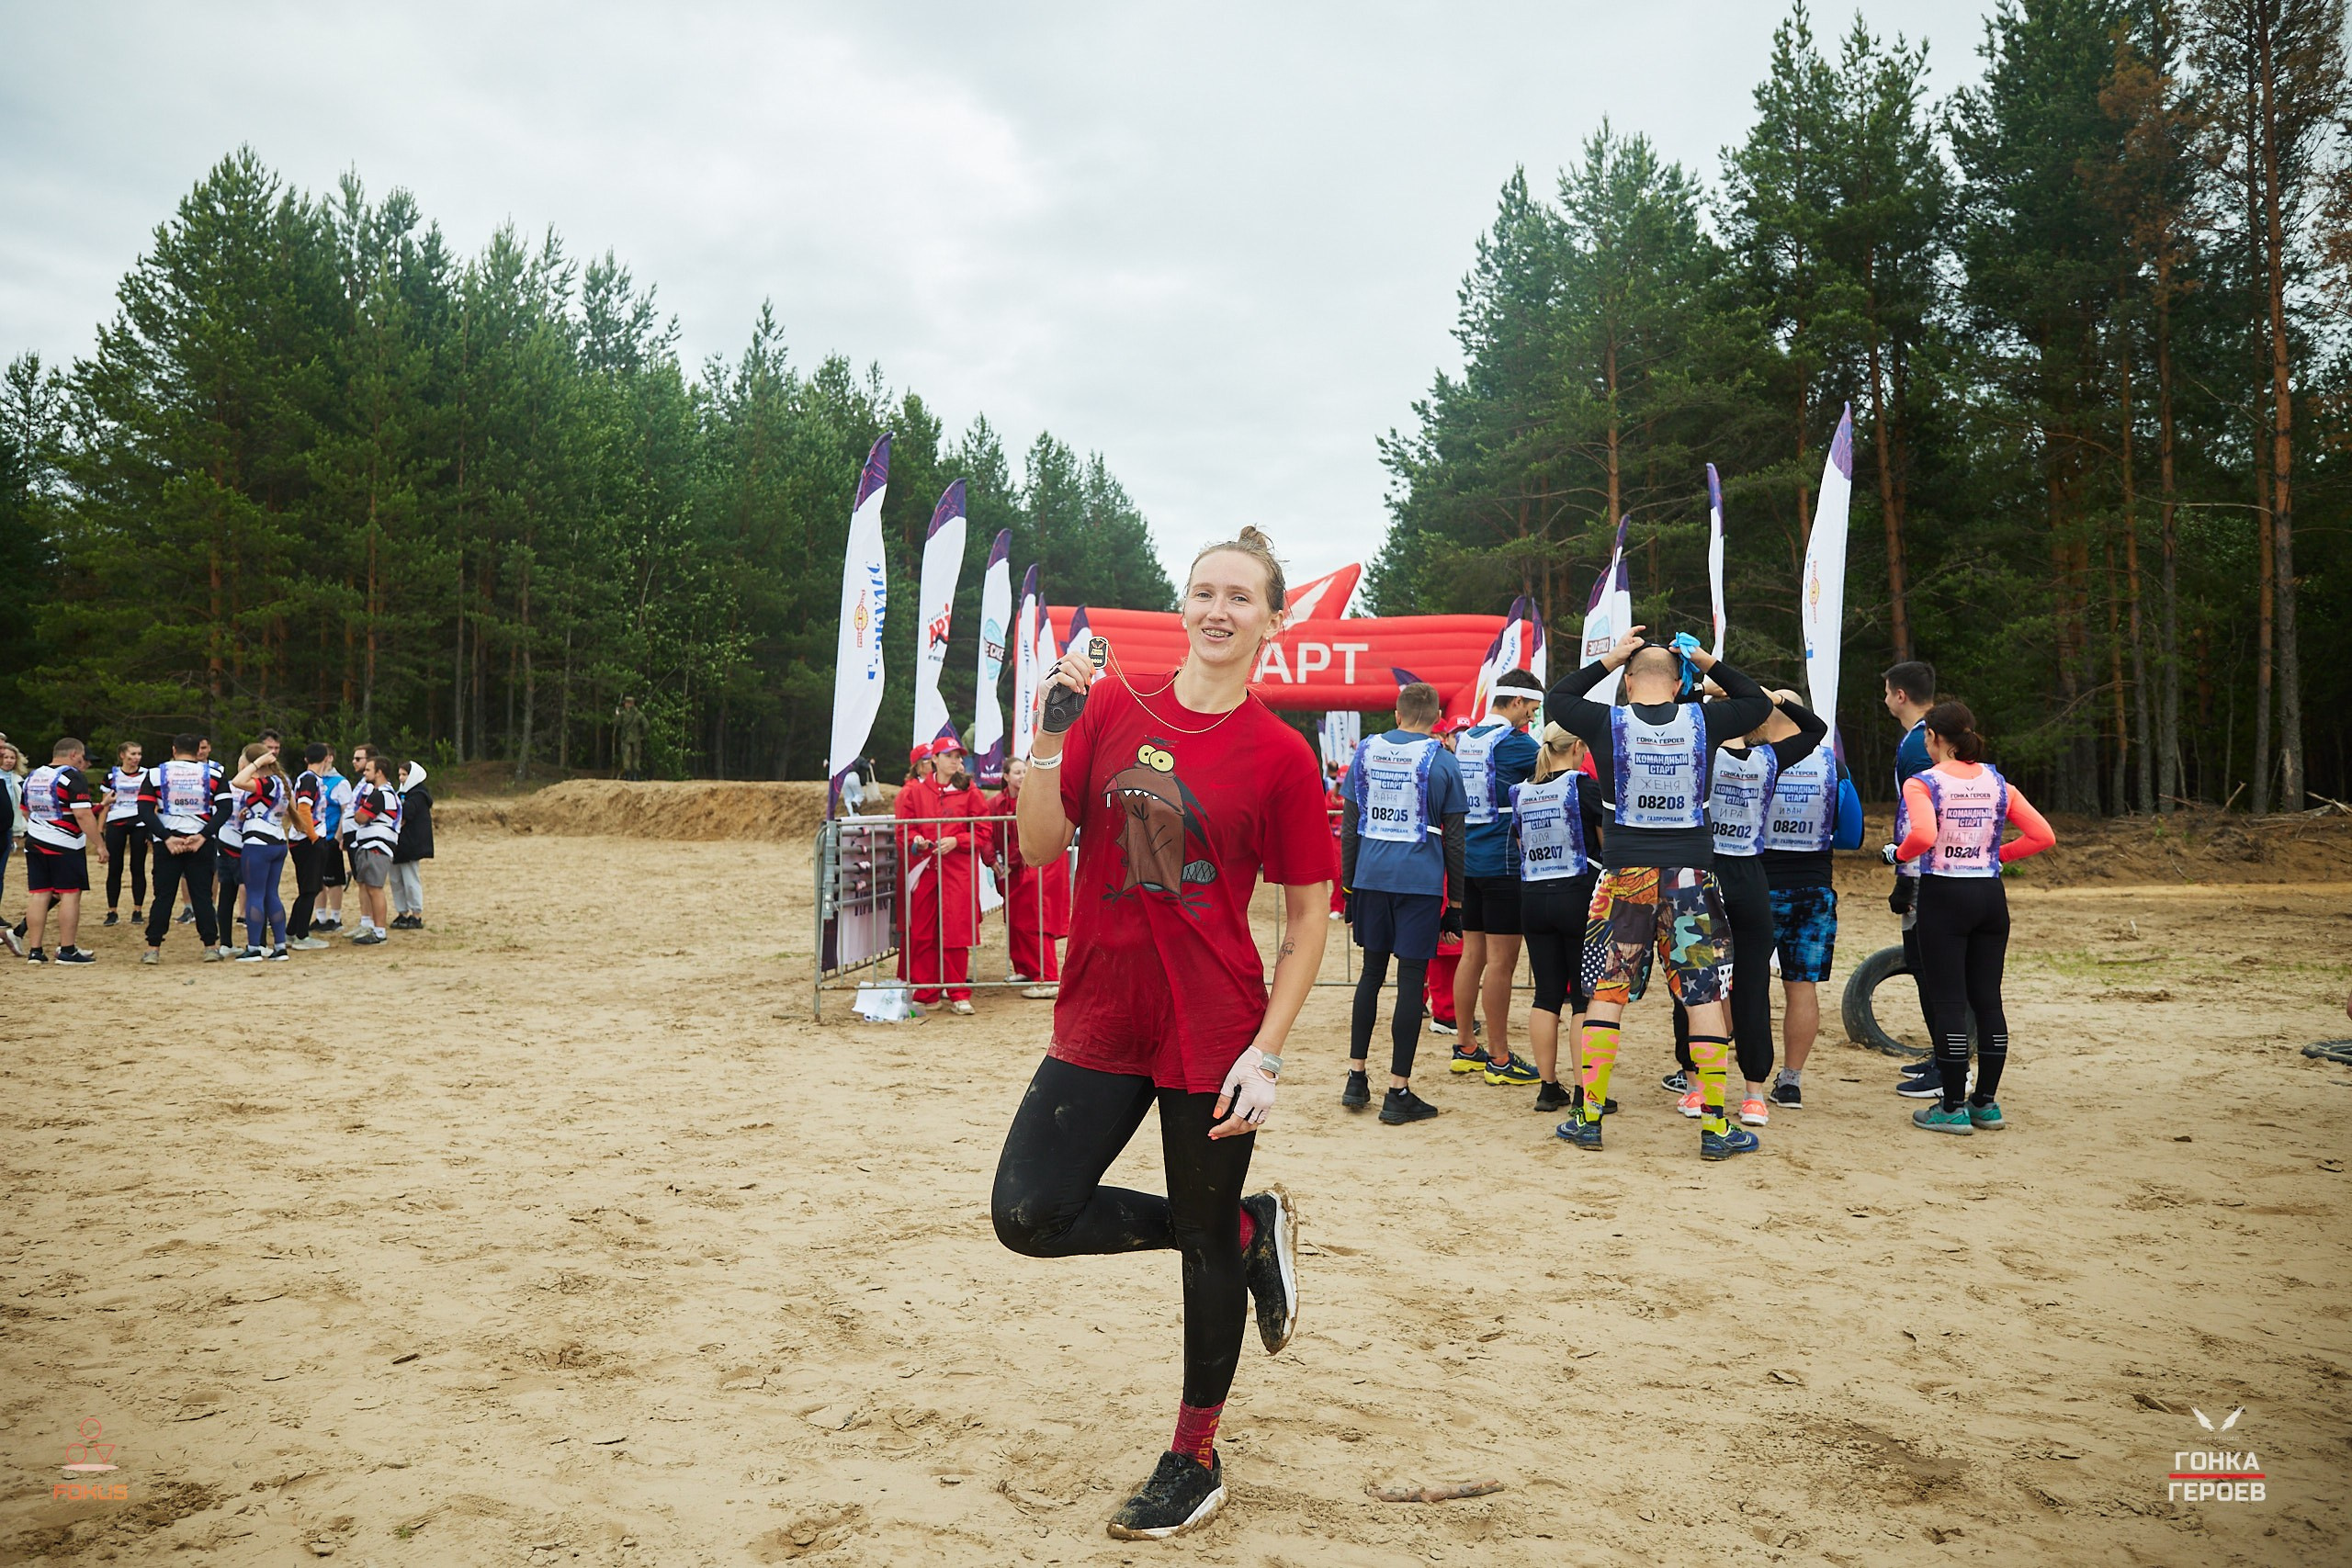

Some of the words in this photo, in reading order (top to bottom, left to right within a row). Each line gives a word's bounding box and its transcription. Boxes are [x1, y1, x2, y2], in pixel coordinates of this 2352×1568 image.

[1635, 752, 1689, 765] КОМАНДНЫЙ
[1649, 765, 1675, 774] СТАРТ
[1720, 770, 1740, 778] ГОНКА
[1381, 780, 1402, 790] СТАРТ
[1641, 778, 1680, 791] ЖЕНЯ
[1374, 791, 1397, 802] ВАНЯ
[1637, 795, 1685, 809] 08208
[1785, 794, 1808, 803] СТАРТ
[1372, 807, 1408, 822] 08205
[1719, 808, 1743, 818] ИРА
[1780, 807, 1802, 815] ИВАН
[1531, 818, 1551, 829] СТАРТ
[1773, 819, 1814, 834] 08201
[1959, 818, 1982, 827] СТАРТ
[1713, 821, 1752, 839] 08202
[1531, 832, 1550, 843] ОЛЯ
[1529, 845, 1563, 862] 08207
[1945, 845, 1981, 859] 08204
